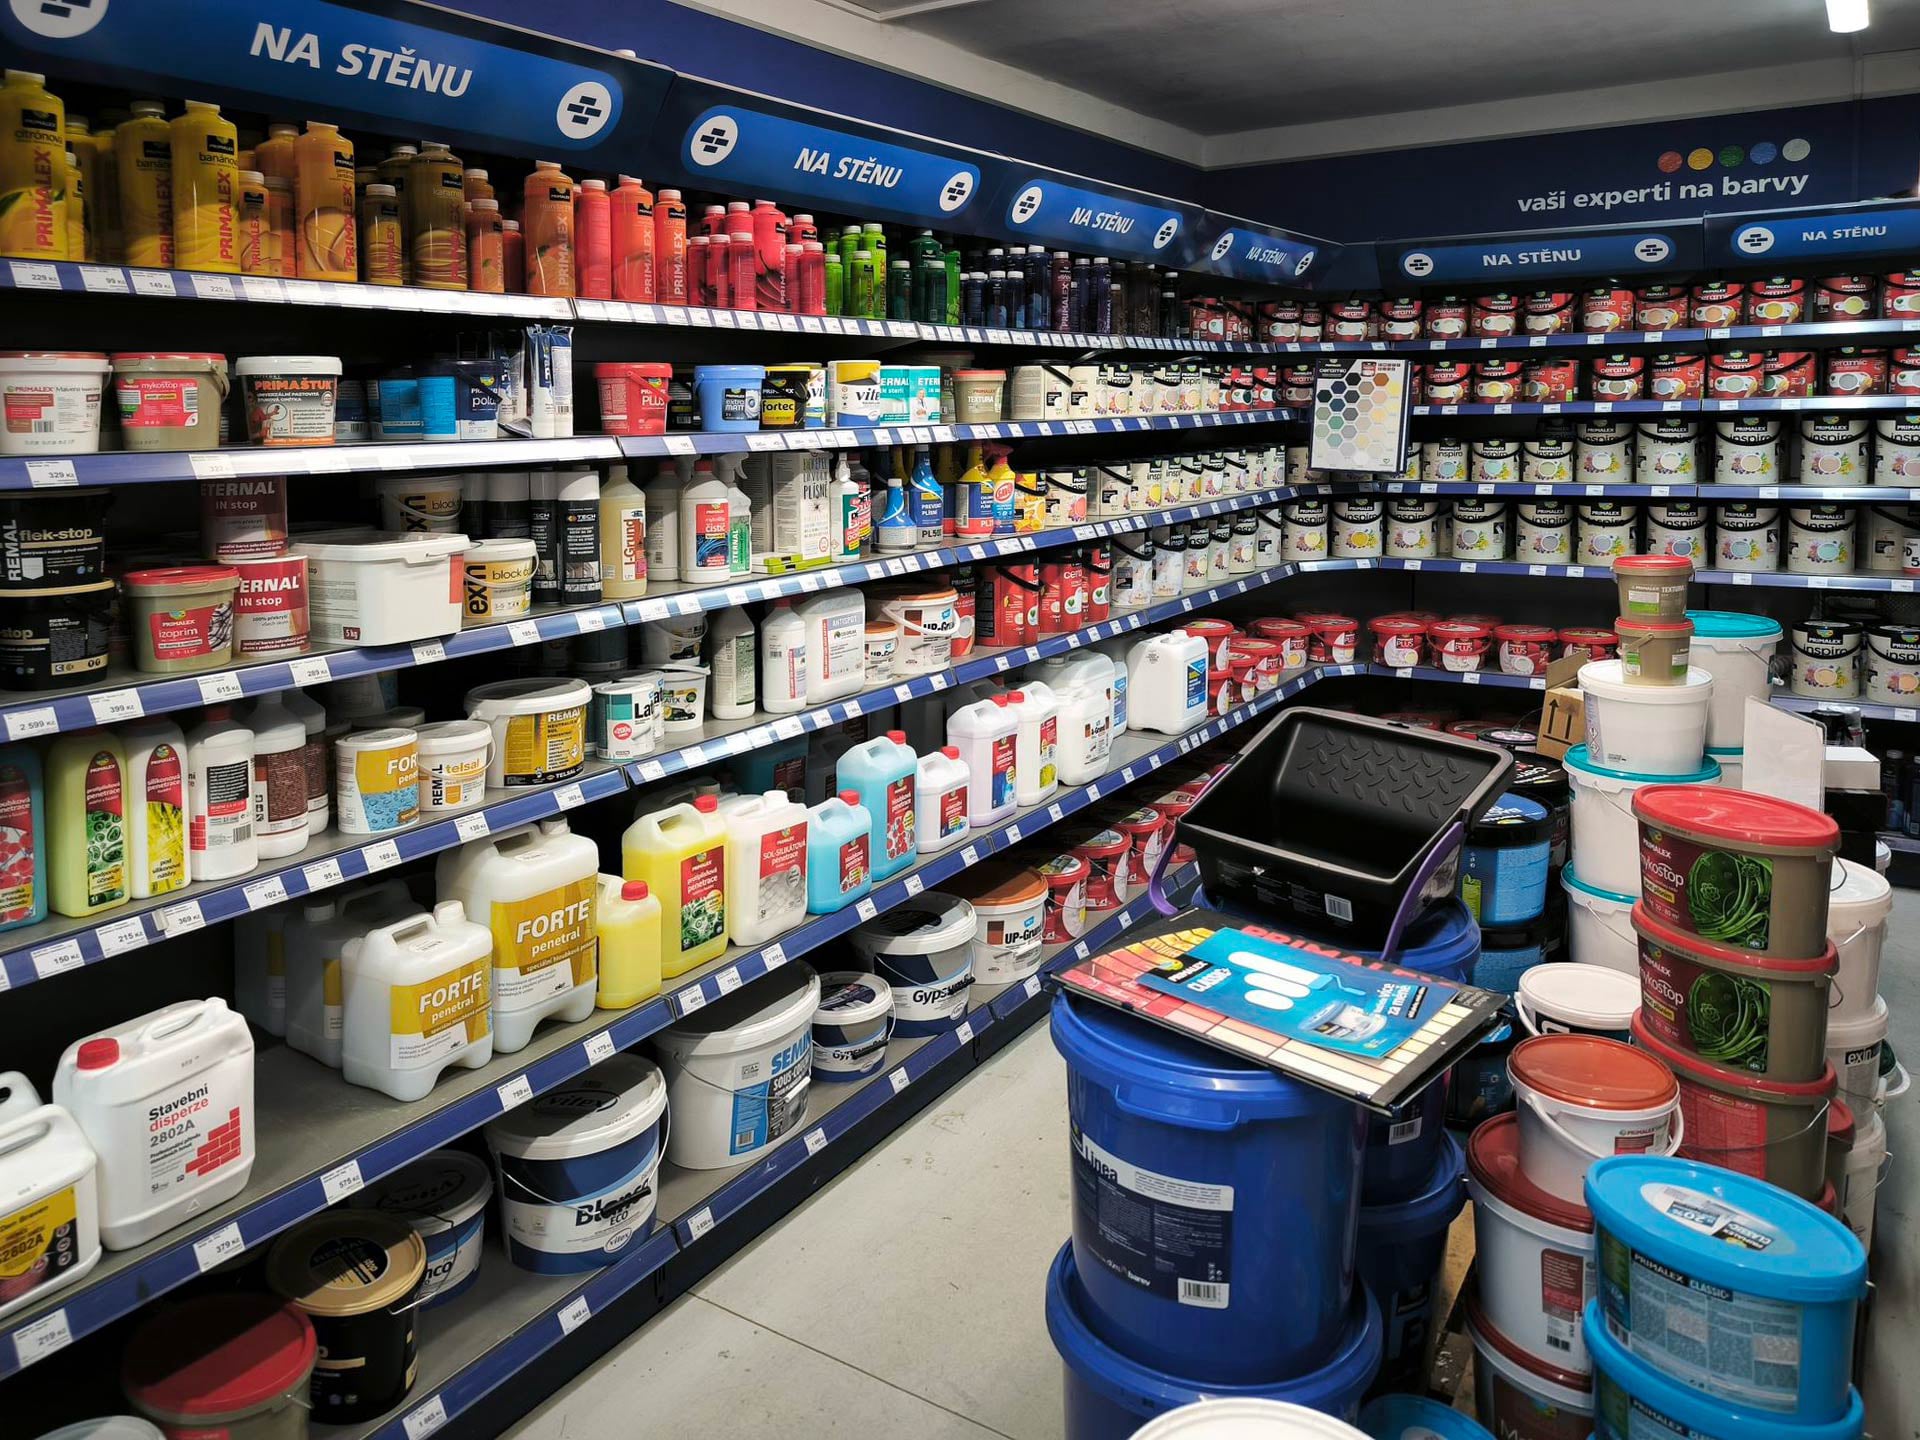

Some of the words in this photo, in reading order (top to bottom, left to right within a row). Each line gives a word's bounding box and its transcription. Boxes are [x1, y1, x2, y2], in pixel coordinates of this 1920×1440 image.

[250, 22, 321, 69] NA
[336, 46, 473, 98] STĚNU
[794, 148, 829, 175] NA
[834, 156, 903, 188] STĚNU
[34, 149, 54, 248] PRIMALEX
[1517, 192, 1566, 213] vaši
[1573, 182, 1672, 210] experti
[1678, 181, 1714, 199] na
[1722, 172, 1810, 197] barvy
[218, 170, 233, 259] PRIMALEX
[1069, 207, 1091, 227] NA
[1092, 211, 1134, 234] STĚNU
[1802, 228, 1827, 242] NA
[1830, 224, 1887, 240] STĚNU
[558, 217, 568, 288] PRIMALEX
[644, 229, 652, 295] PRIMALEX
[1246, 246, 1259, 261] NA
[1259, 248, 1286, 265] STĚNU
[1483, 252, 1513, 267] NA
[1517, 248, 1582, 266] STĚNU
[674, 231, 683, 296] PRIMALEX
[255, 378, 332, 391] PRIMAŠTUK
[762, 400, 794, 412] fortec
[230, 500, 257, 511] stop
[20, 528, 93, 541] flek-stop
[3, 519, 22, 581] REMAL
[239, 577, 300, 593] ERNAL
[492, 570, 521, 582] block
[464, 564, 488, 615] exin
[240, 598, 252, 607] IN
[255, 596, 282, 607] stop
[159, 628, 198, 638] izoprim
[110, 705, 125, 713] 399
[445, 758, 480, 774] telsal
[87, 787, 120, 801] penetrace
[1643, 838, 1672, 859] PRIMALEX
[264, 891, 278, 900] 102
[178, 916, 192, 925] 369
[515, 898, 591, 943] FORTE
[118, 933, 133, 943] 215
[531, 930, 580, 956] penetral
[54, 954, 70, 964] 150
[419, 970, 483, 1014] FORTE
[431, 996, 475, 1025] penetral
[1848, 1049, 1872, 1064] exin
[149, 1098, 209, 1132] disperze
[150, 1119, 195, 1147] 2802A
[610, 1211, 628, 1225] ECO
[1634, 1253, 1684, 1284] PRIMALEX
[1689, 1279, 1731, 1300] CLASSIC
[1633, 1400, 1683, 1433] PRIMALEX
